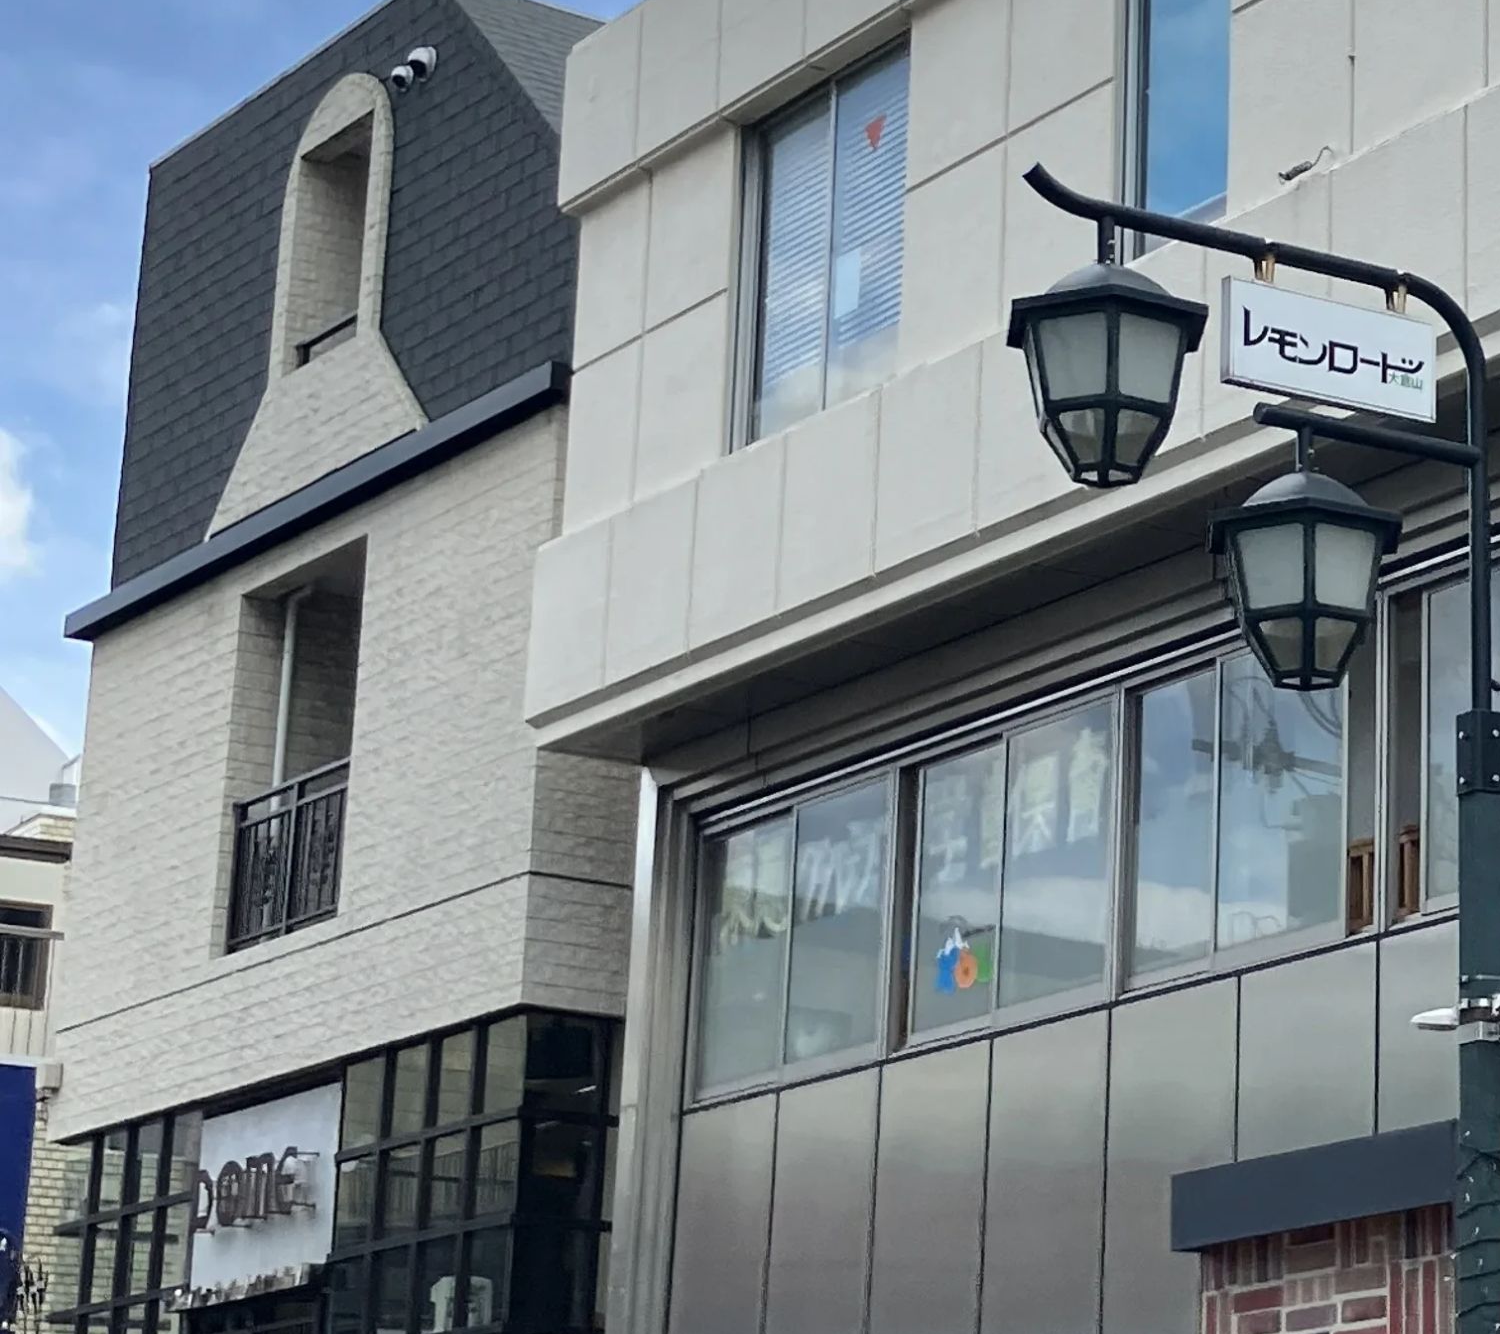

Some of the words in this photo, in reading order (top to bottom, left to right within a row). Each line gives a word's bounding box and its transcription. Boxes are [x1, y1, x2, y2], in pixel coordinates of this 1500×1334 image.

[1243, 305, 1425, 384] レモンロード
[1388, 372, 1424, 391] 大倉山
